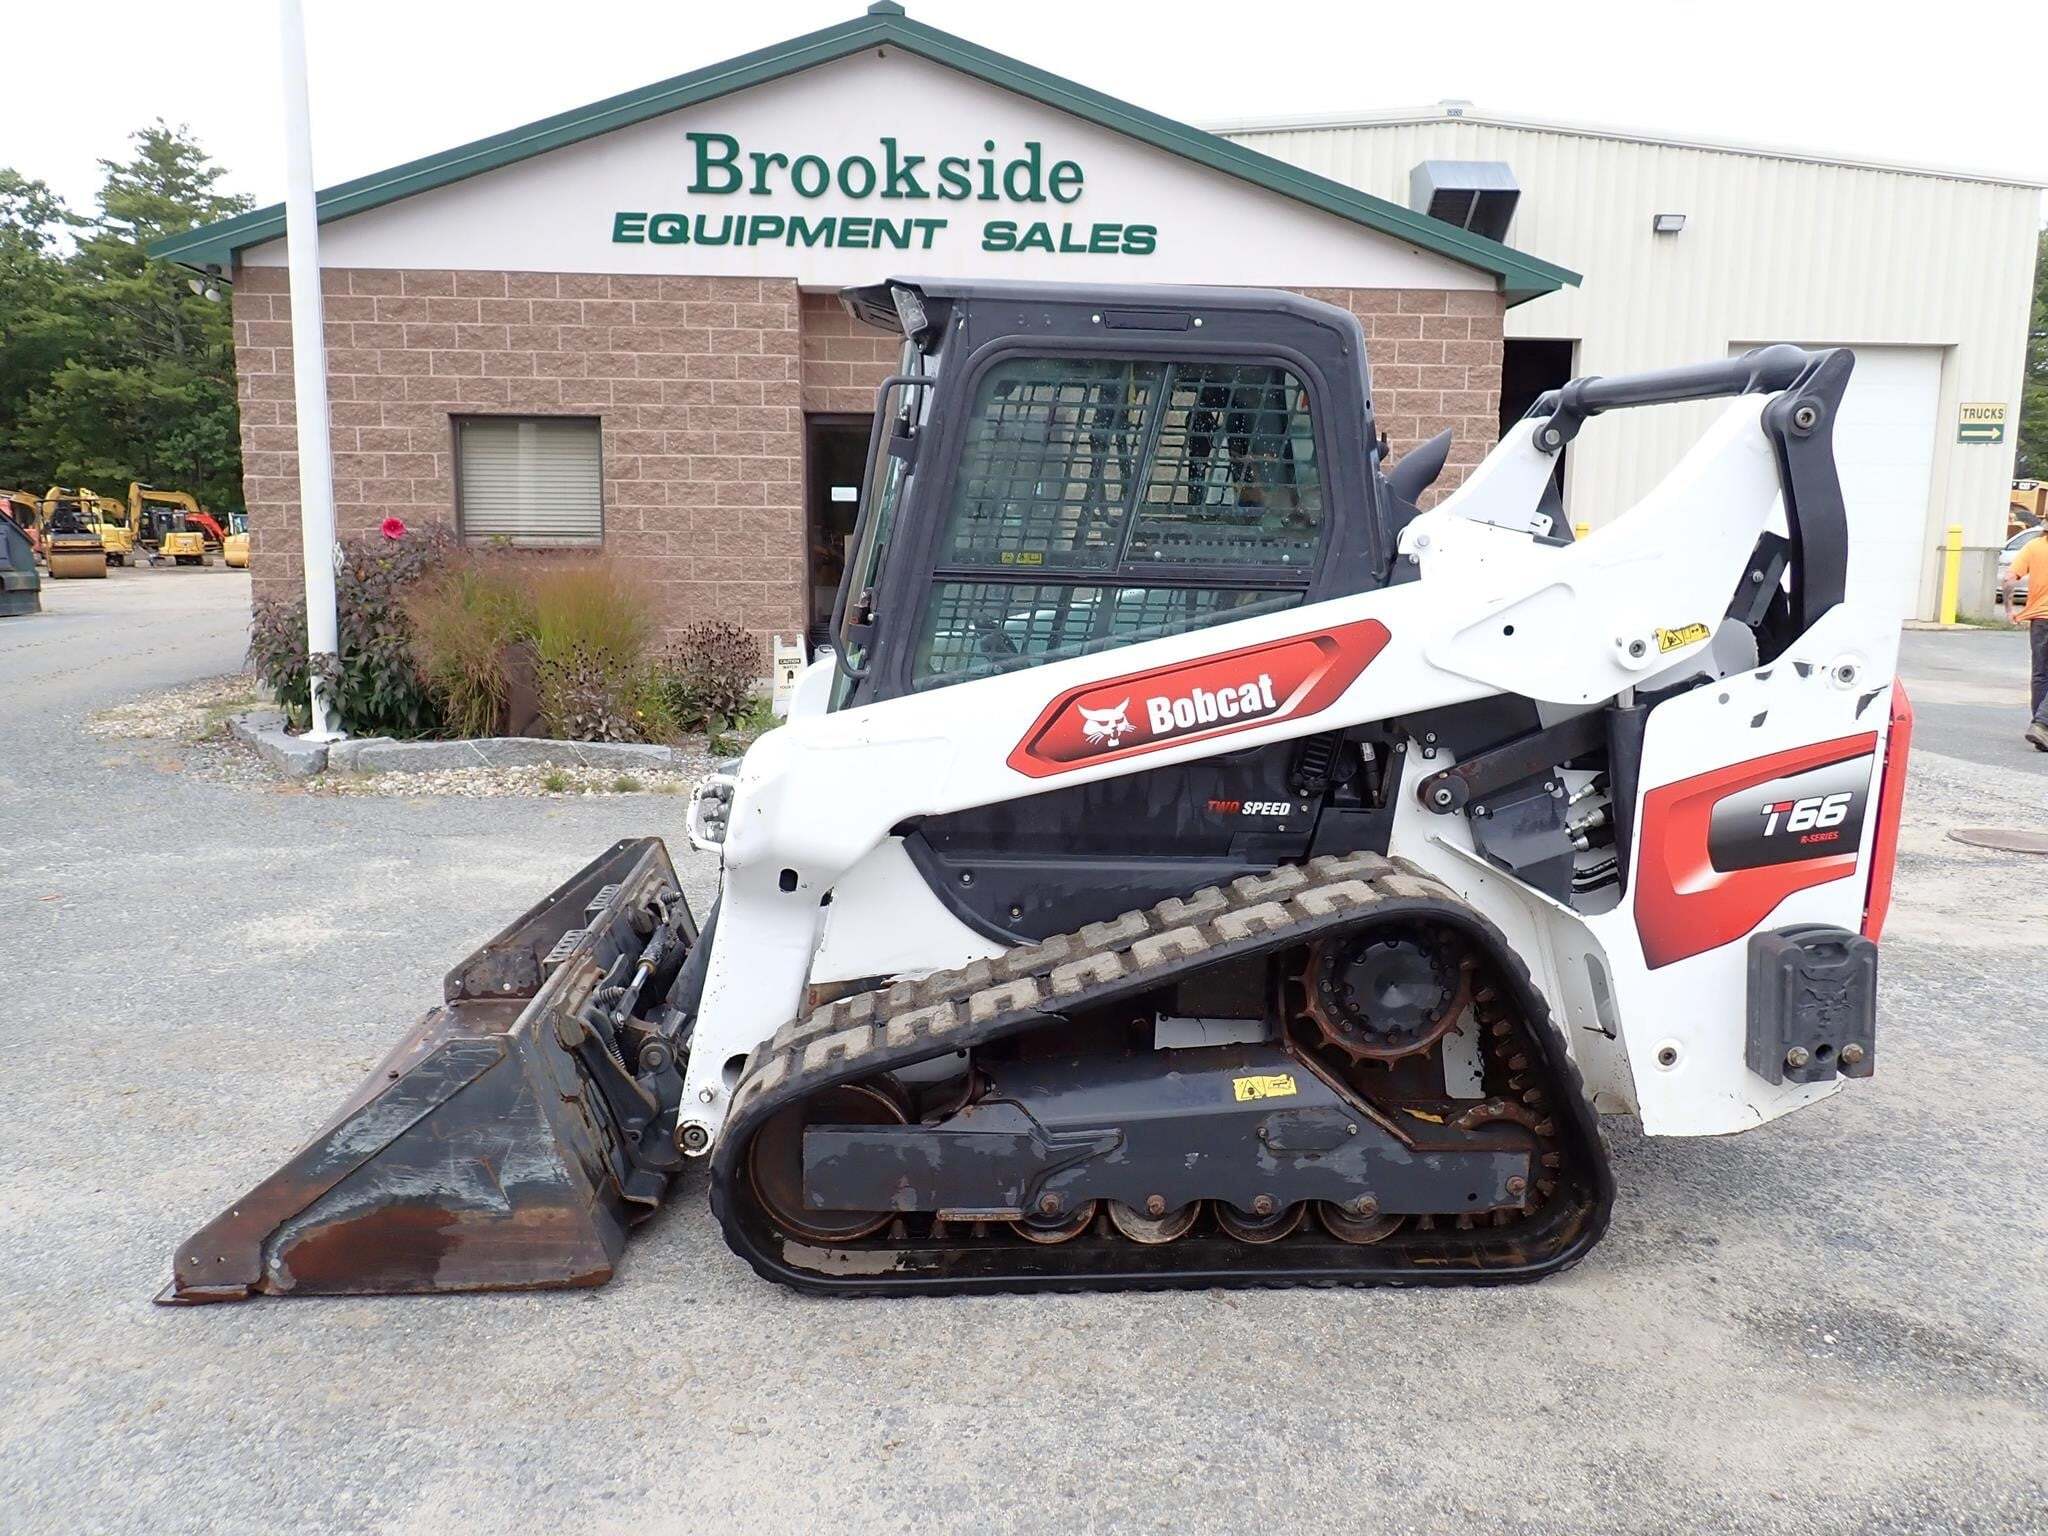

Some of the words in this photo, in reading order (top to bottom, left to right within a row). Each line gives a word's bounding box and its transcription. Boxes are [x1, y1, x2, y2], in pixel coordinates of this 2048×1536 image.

[686, 132, 1084, 204] Brookside
[612, 212, 948, 249] EQUIPMENT
[982, 221, 1158, 255] SALES
[1963, 408, 2004, 419] TRUCKS
[1146, 673, 1276, 735] Bobcat
[1207, 800, 1240, 813] TWO
[1242, 801, 1291, 816] SPEED
[1762, 792, 1853, 837] T66
